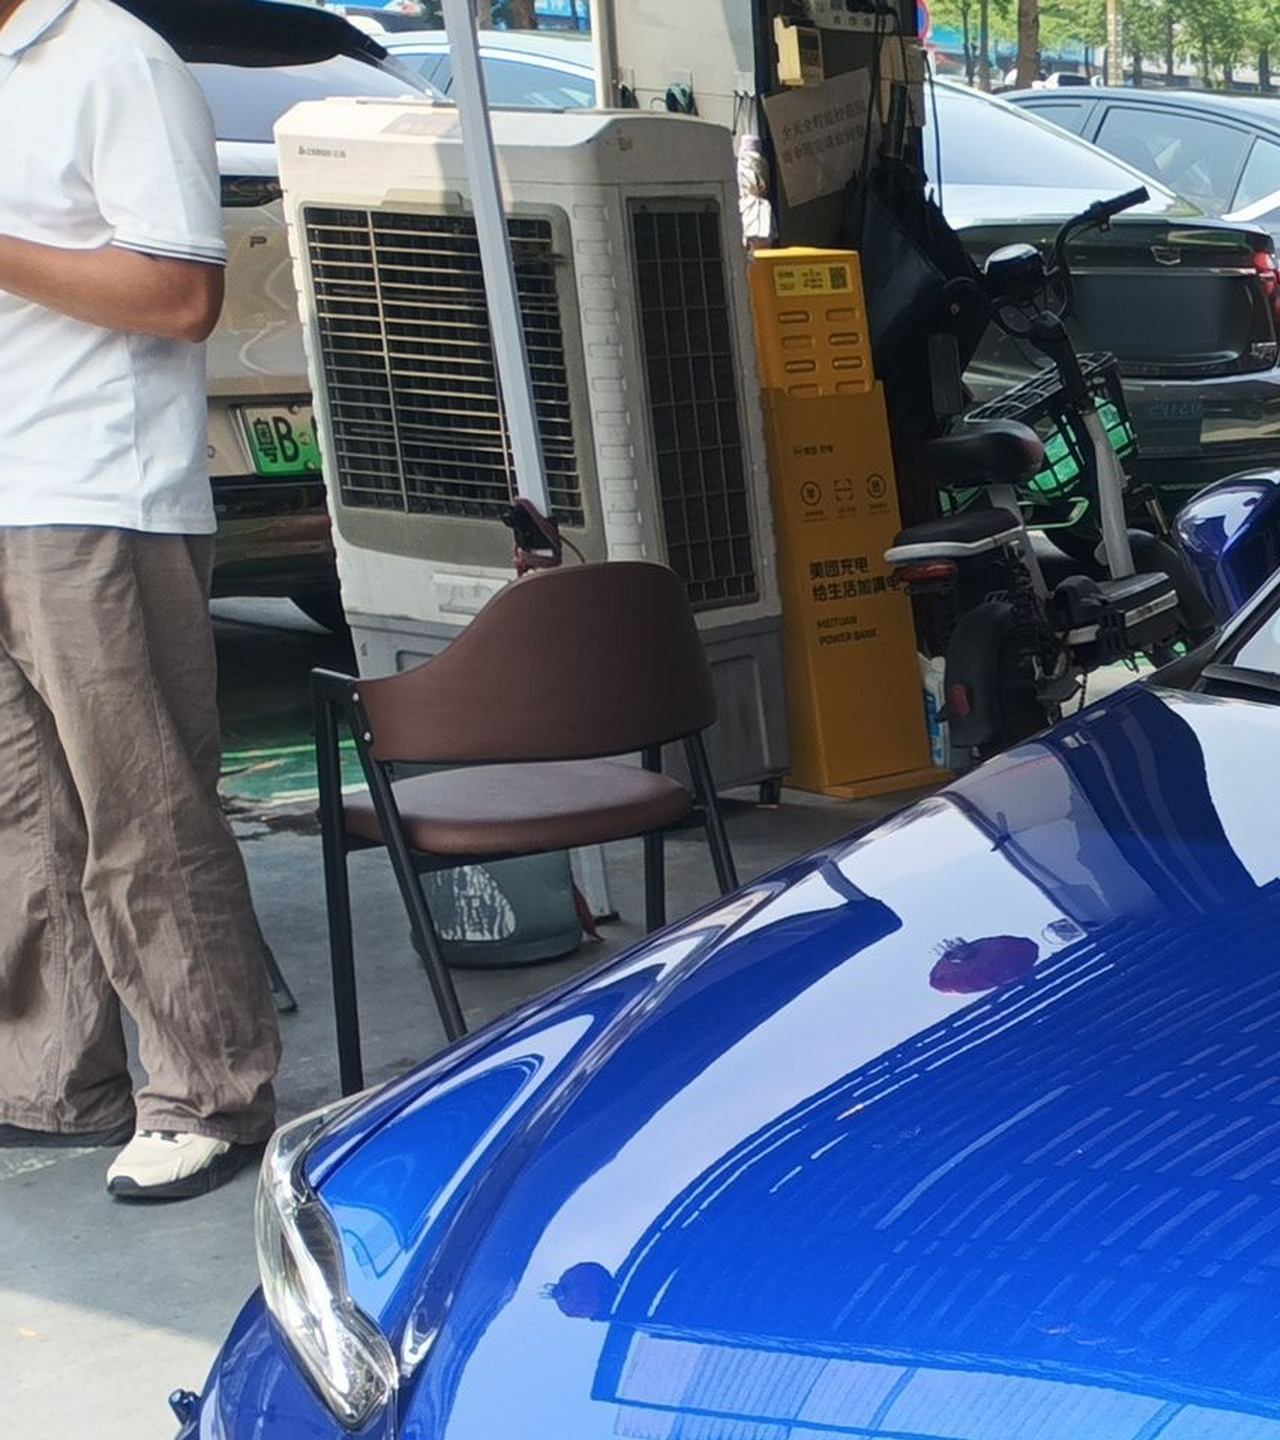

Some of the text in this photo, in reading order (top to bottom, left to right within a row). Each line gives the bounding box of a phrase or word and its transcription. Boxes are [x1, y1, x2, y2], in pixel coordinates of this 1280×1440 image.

[253, 416, 321, 463] 粤B
[809, 556, 869, 580] 美团充电
